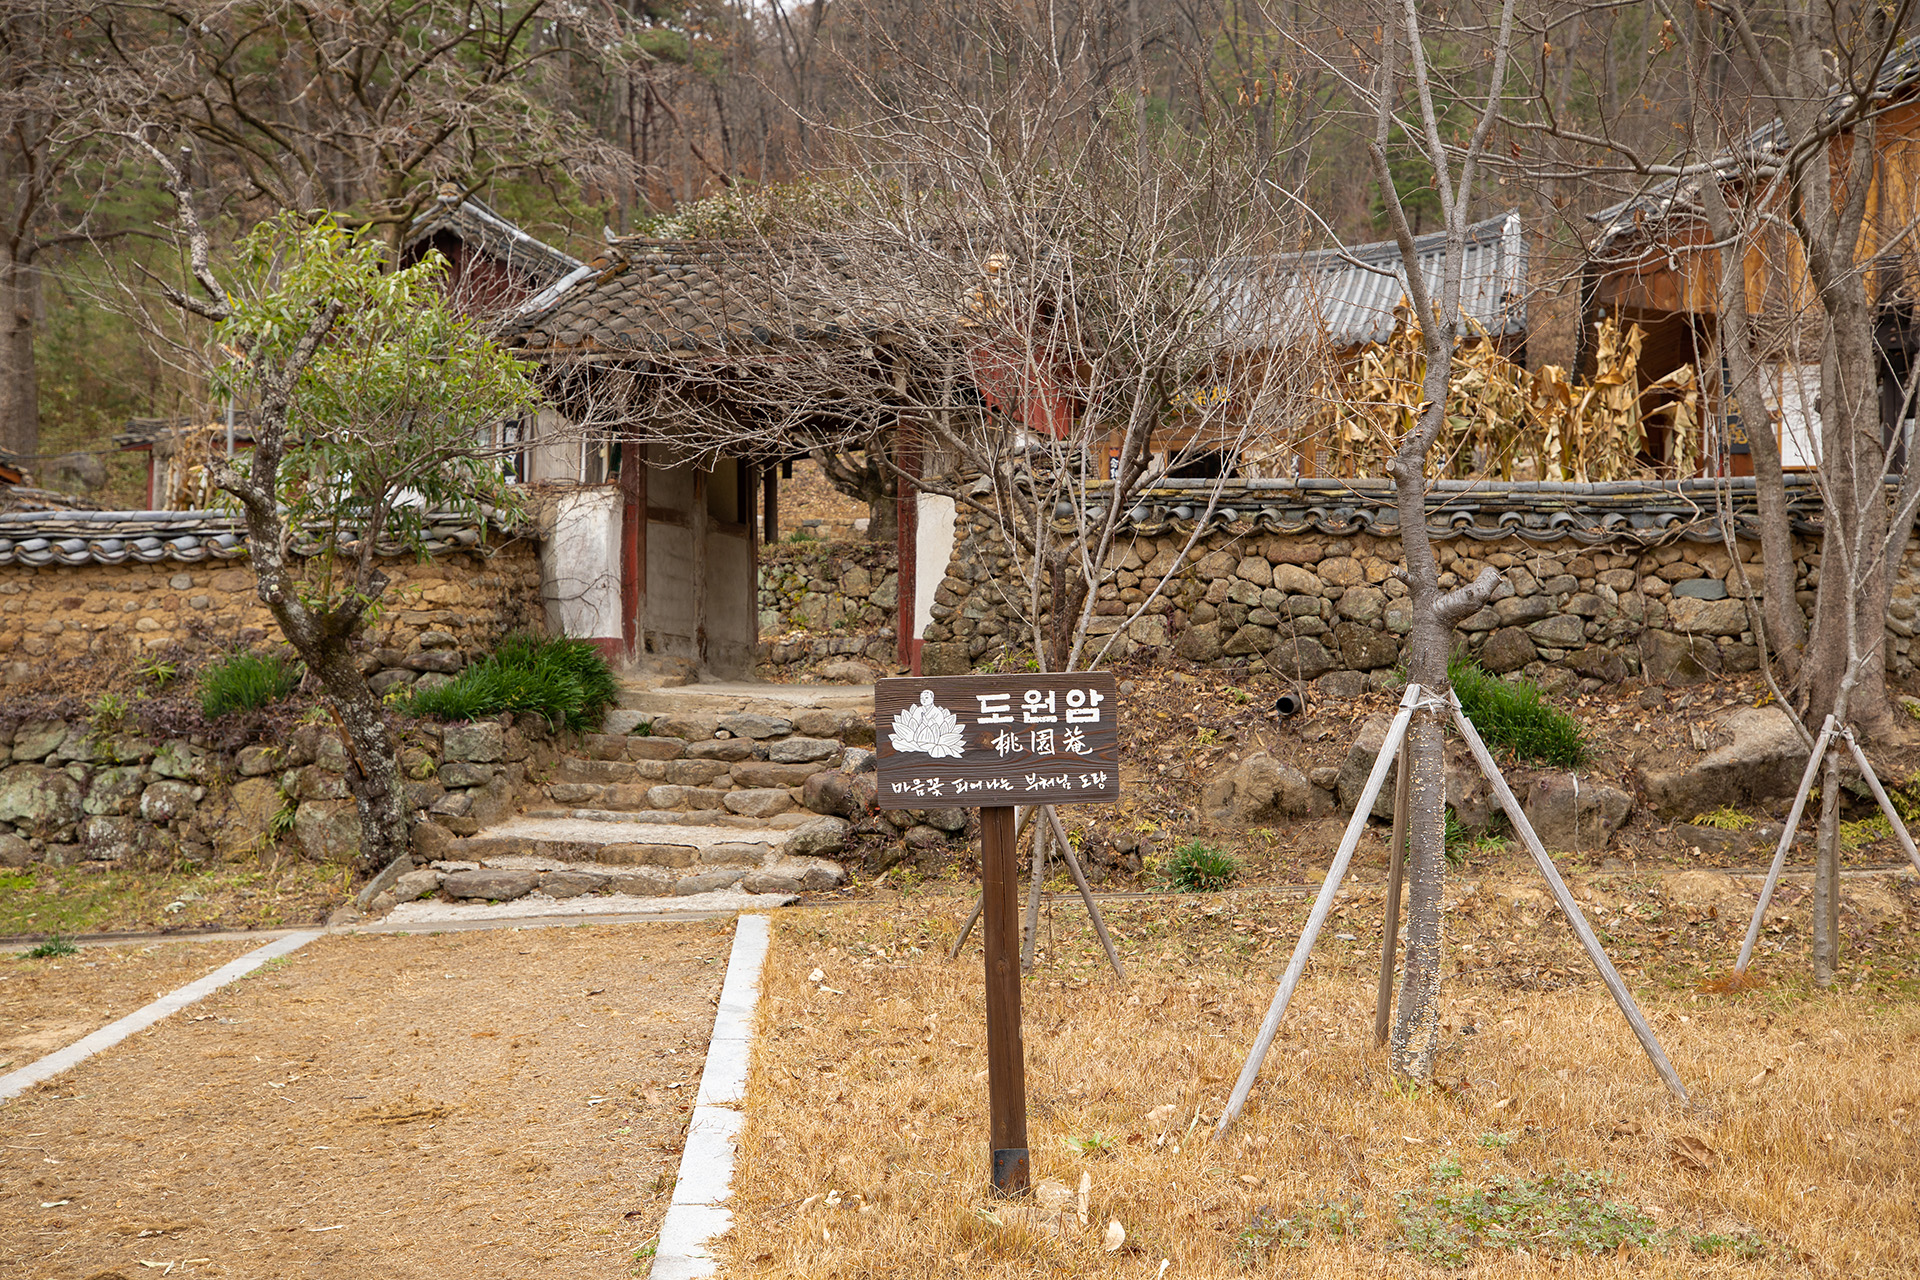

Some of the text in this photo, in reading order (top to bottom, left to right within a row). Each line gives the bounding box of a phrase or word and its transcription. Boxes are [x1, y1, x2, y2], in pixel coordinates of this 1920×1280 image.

[976, 689, 1105, 724] 도원암
[891, 770, 1108, 797] 마음꽃 피어나는 부처님 도량
